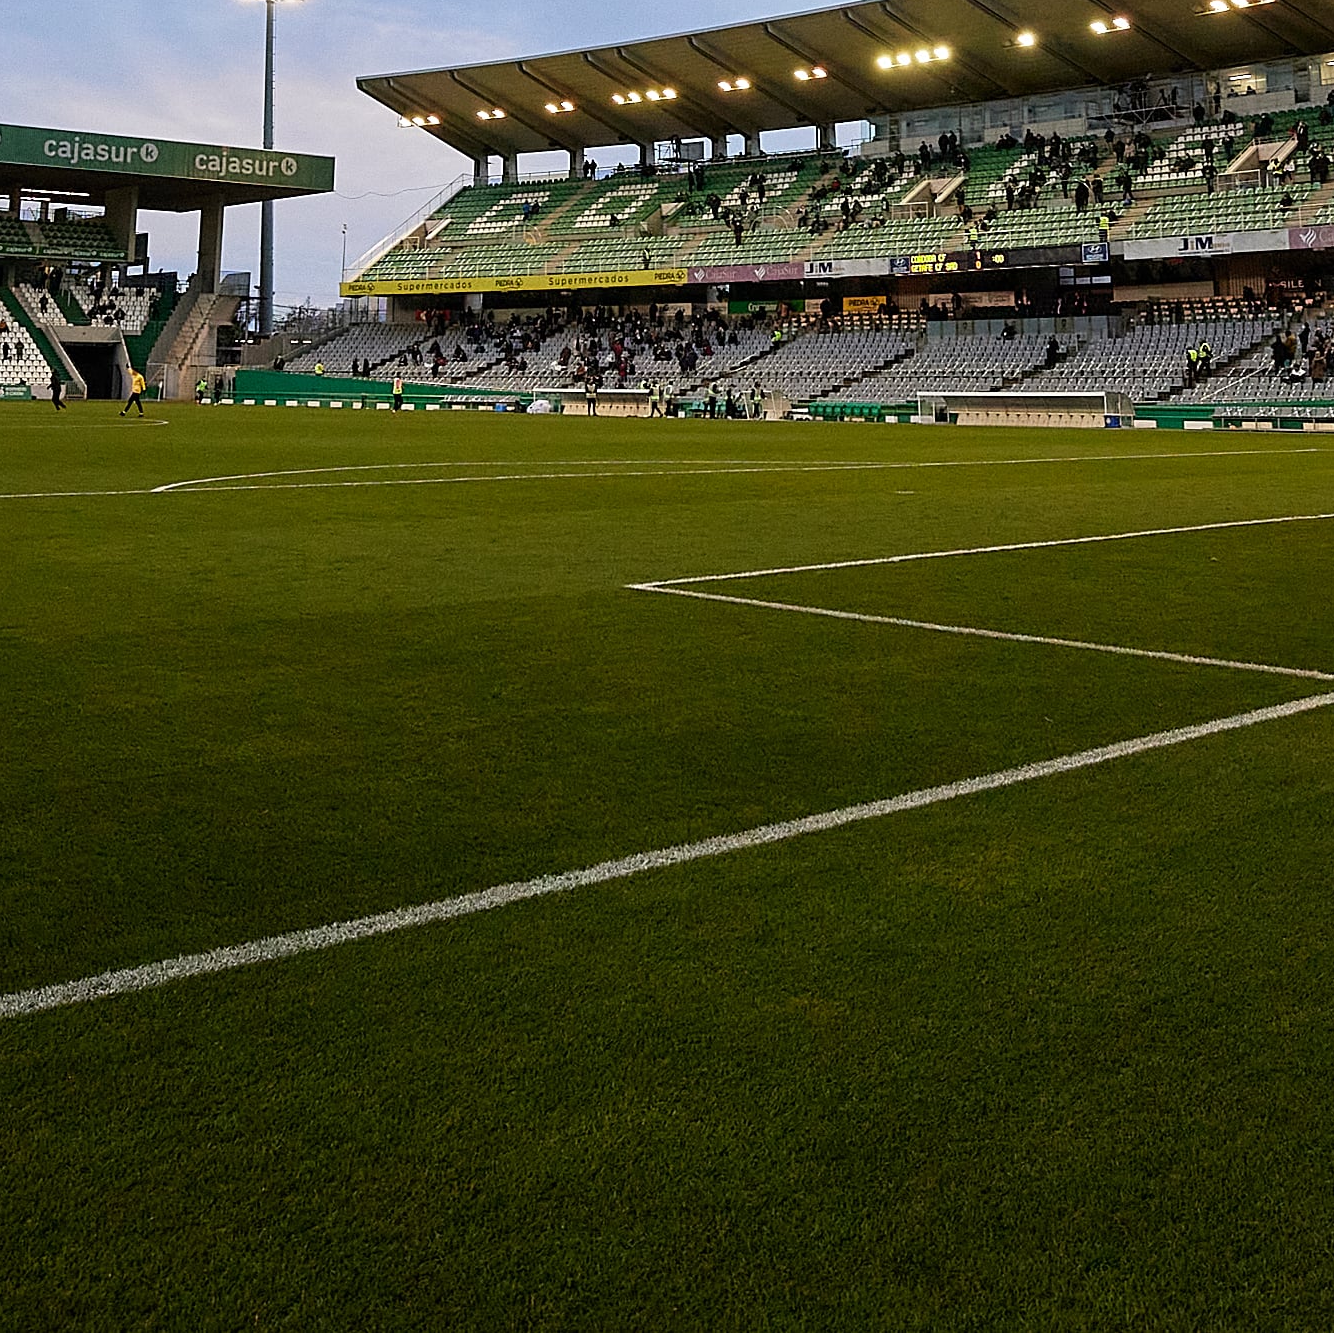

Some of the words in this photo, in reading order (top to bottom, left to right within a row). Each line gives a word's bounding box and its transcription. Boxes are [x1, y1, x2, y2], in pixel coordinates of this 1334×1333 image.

[44, 136, 138, 162] cajasur
[195, 151, 279, 176] cajasur
[397, 281, 472, 292] Supermercados
[548, 274, 629, 287] Supermercados
